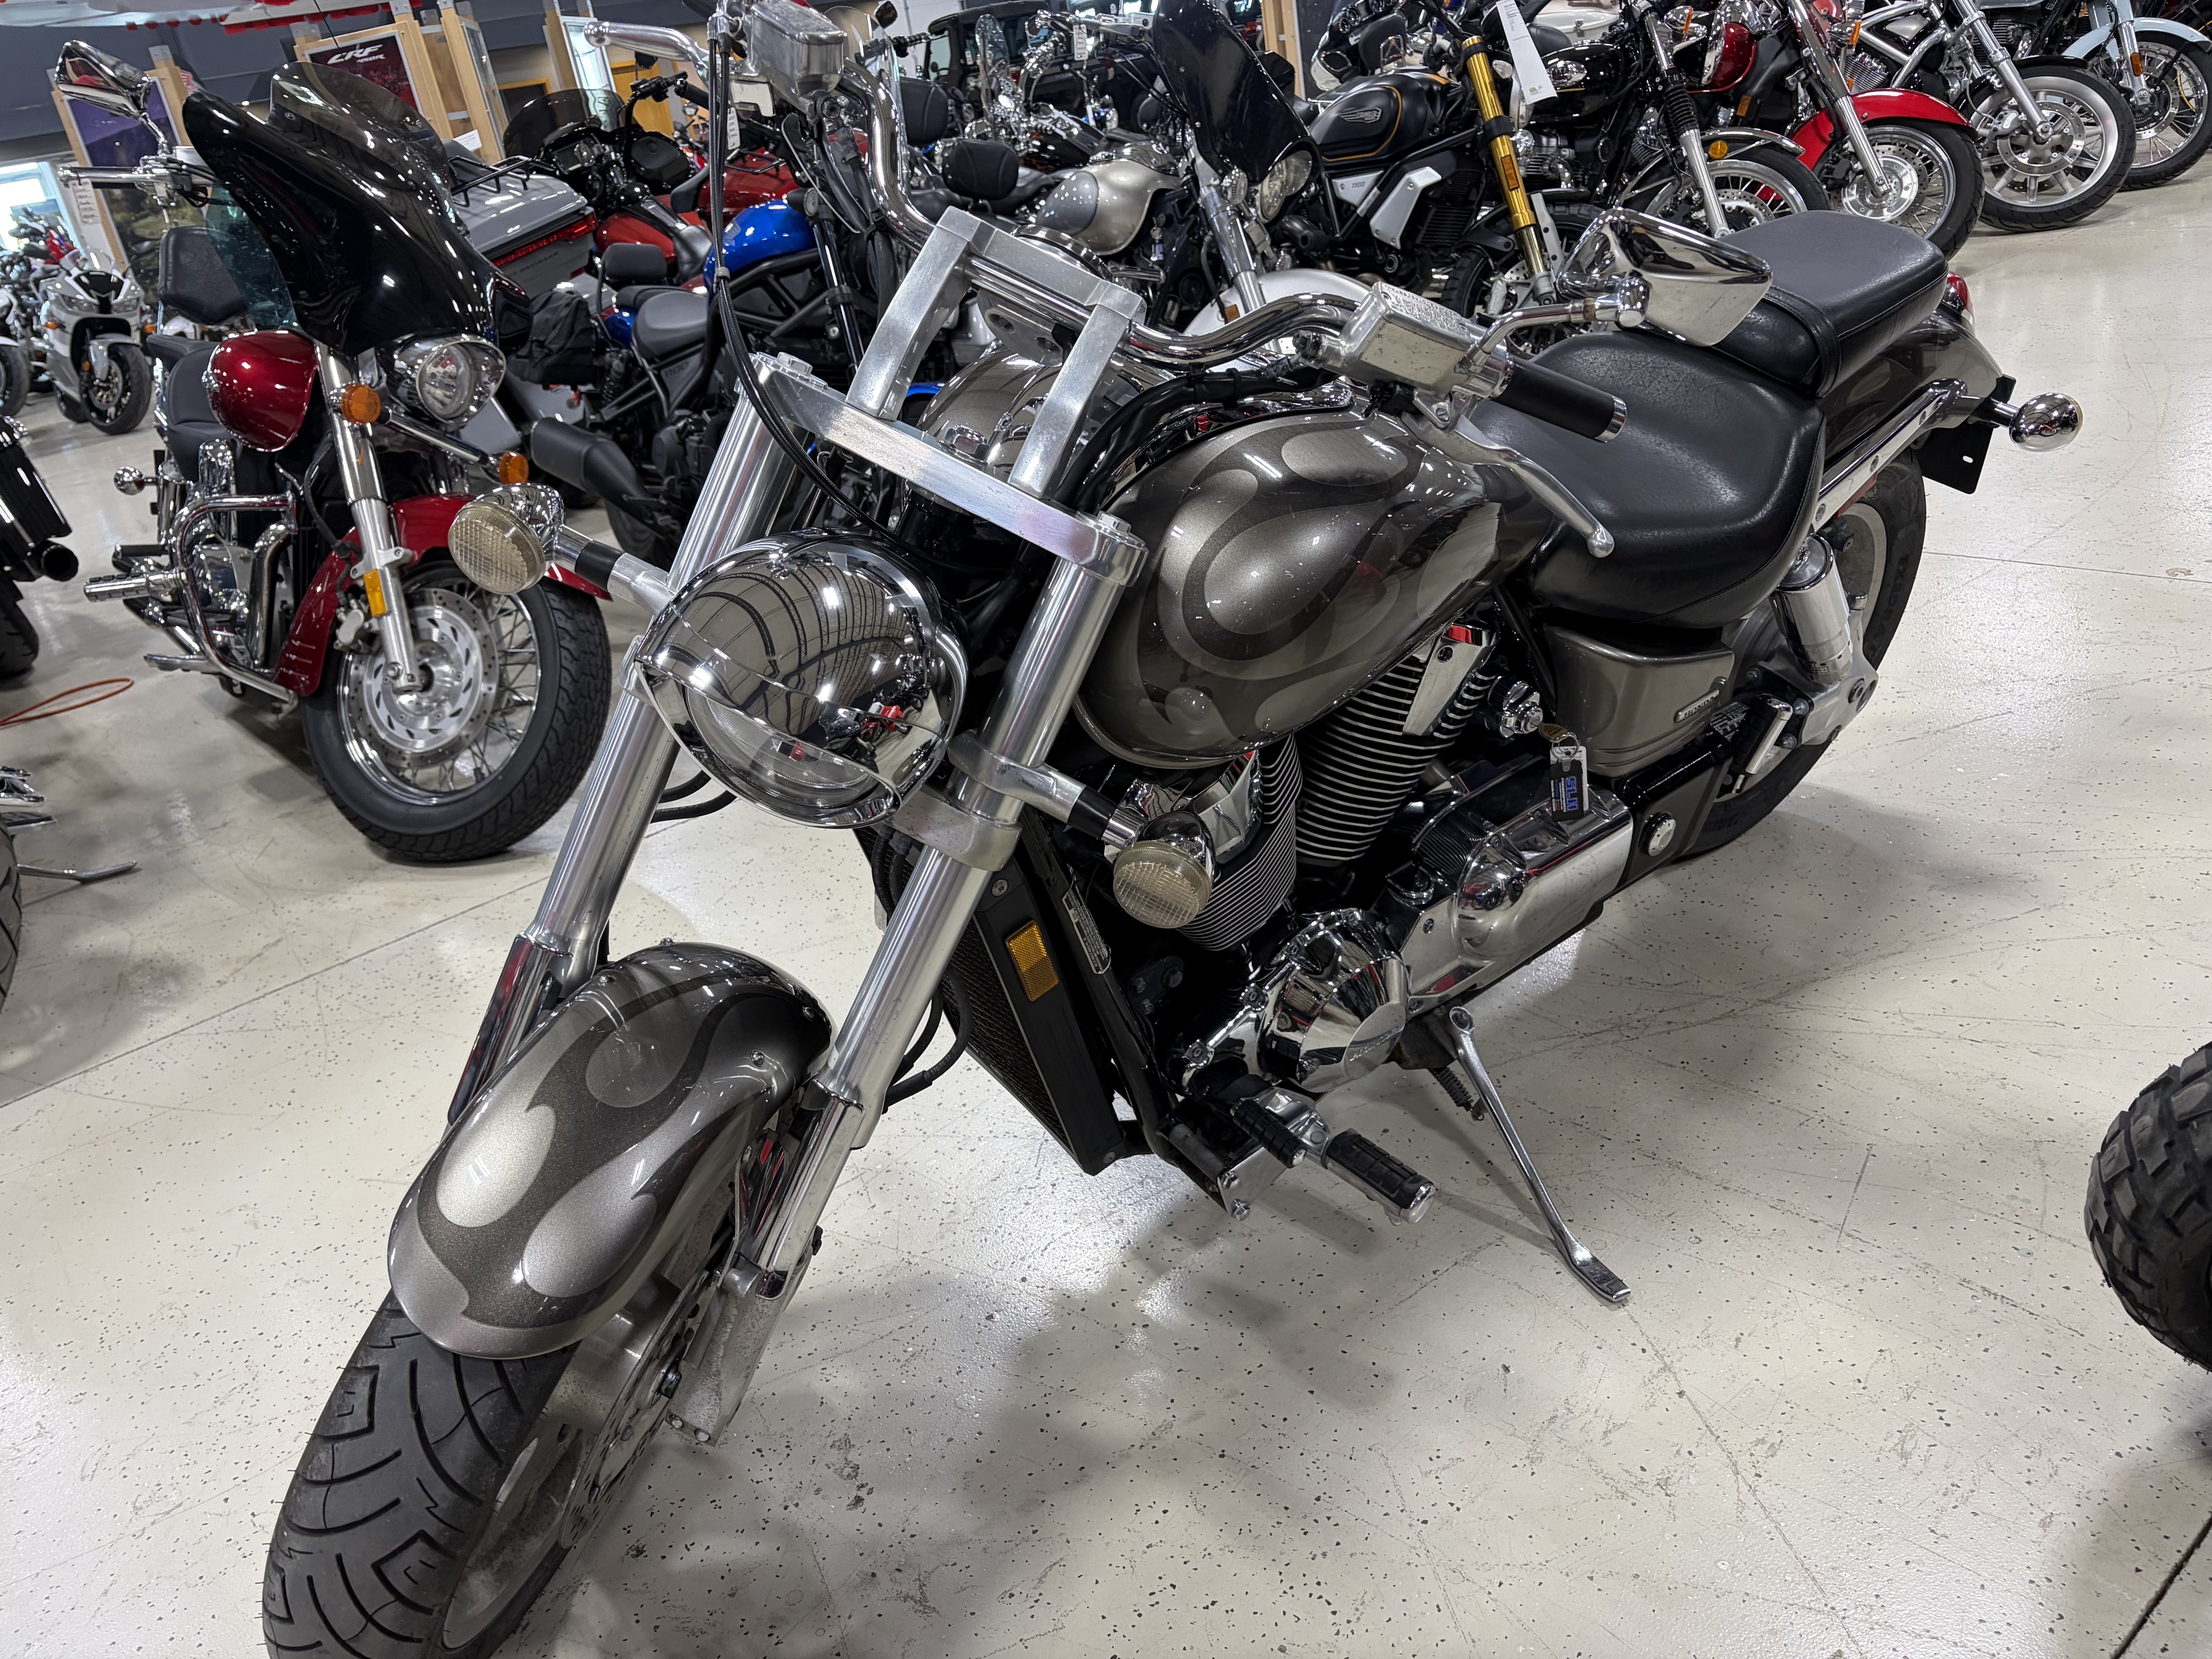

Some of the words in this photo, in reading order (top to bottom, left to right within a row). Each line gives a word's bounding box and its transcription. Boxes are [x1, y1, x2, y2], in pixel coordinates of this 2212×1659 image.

[327, 44, 383, 64] CRF
[1684, 696, 1715, 718] HONDA
[1565, 776, 1578, 811] SLH
